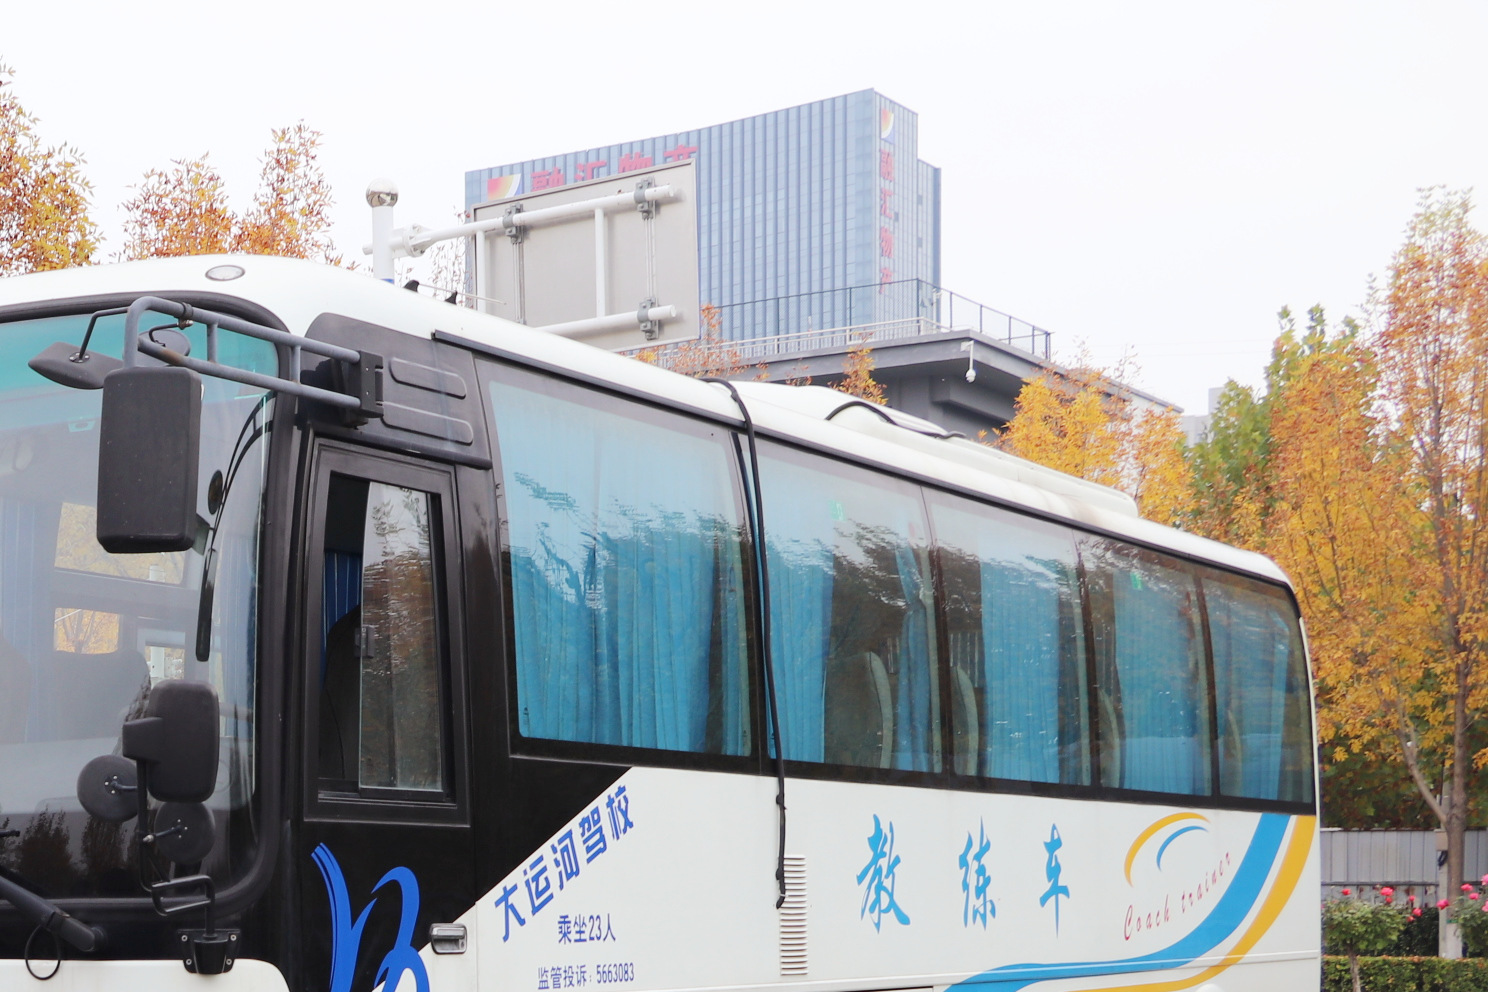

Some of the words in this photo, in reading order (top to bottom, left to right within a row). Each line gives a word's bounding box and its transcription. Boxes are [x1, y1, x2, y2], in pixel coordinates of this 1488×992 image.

[879, 148, 895, 295] 融汇物产
[494, 784, 634, 943] 大运河驾校
[1124, 893, 1170, 941] Coach
[1181, 851, 1230, 914] trainer
[557, 913, 616, 945] 乘坐23人
